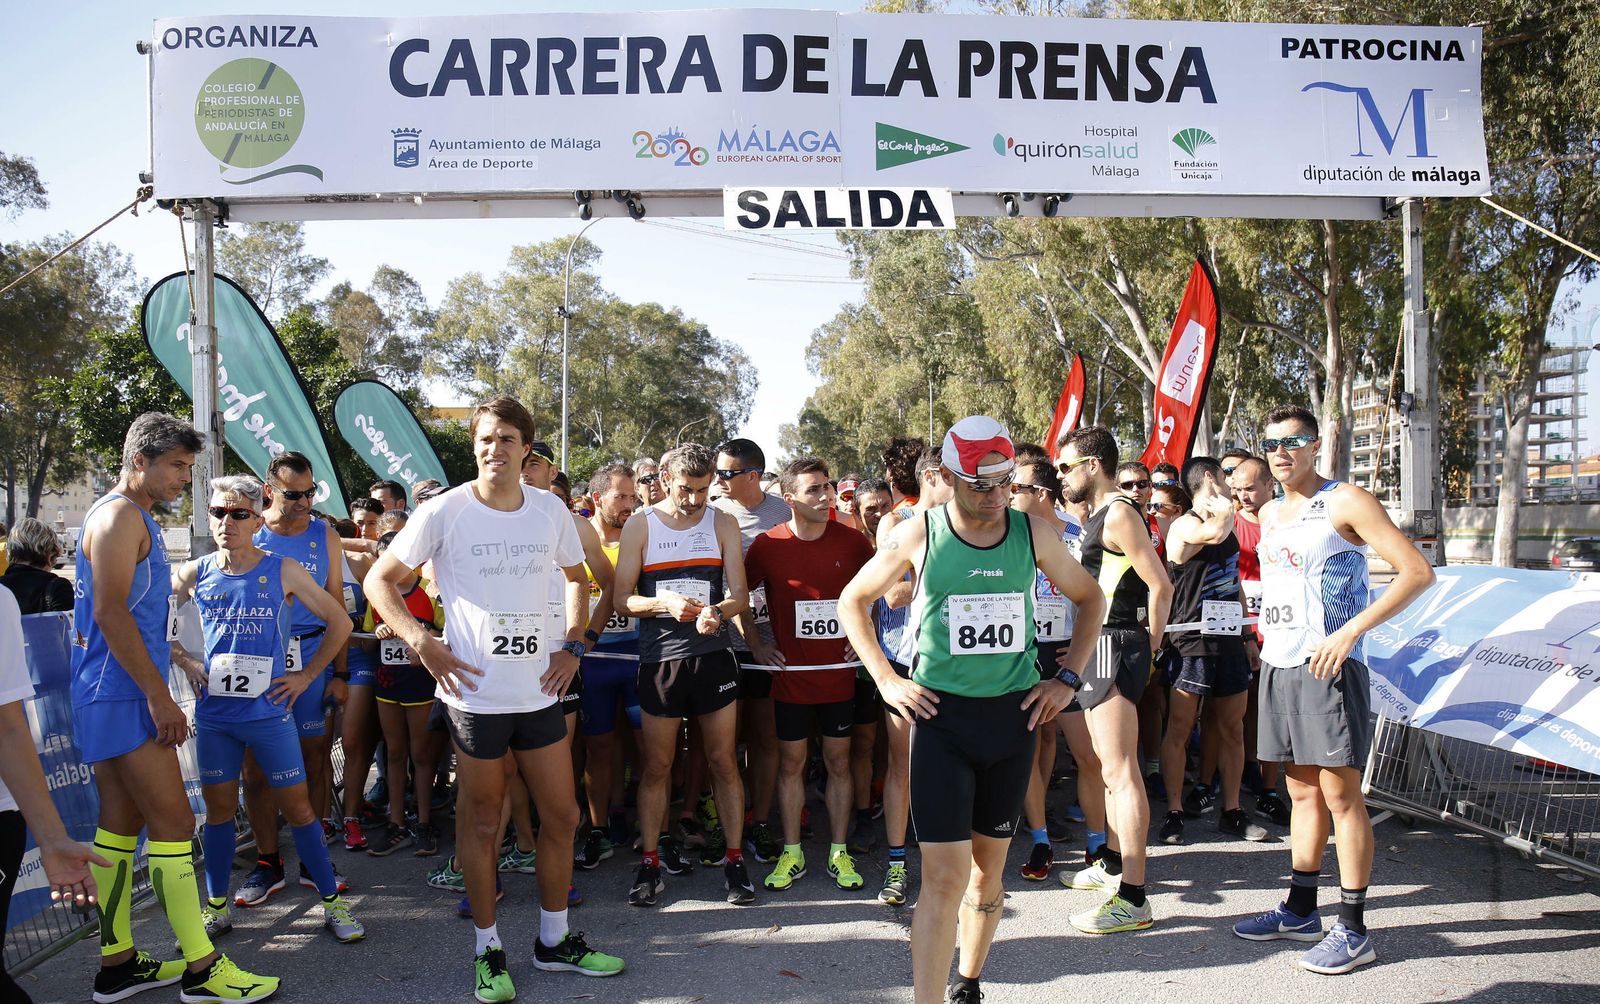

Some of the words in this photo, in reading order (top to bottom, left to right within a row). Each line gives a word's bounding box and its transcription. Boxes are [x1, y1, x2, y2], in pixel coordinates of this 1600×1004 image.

[162, 25, 318, 49] ORGANIZA
[1281, 37, 1465, 61] PATROCINA
[389, 34, 722, 97] CARRERA
[742, 33, 829, 94] DE
[851, 38, 938, 97] LA
[958, 39, 1218, 104] PRENSA
[204, 83, 256, 93] COLEGIO
[204, 95, 282, 106] PROFESIONAL
[285, 95, 300, 105] DE
[204, 108, 275, 119] PERIODISTAS
[279, 108, 293, 117] DE
[204, 119, 268, 131] ANDALUCÍA
[271, 121, 285, 130] EN
[1084, 125, 1138, 139] Hospital
[244, 131, 290, 142] MÁLAGA
[428, 138, 525, 152] Ayuntamiento
[530, 137, 547, 149] de
[551, 137, 601, 151] Málaga
[717, 124, 841, 153] MÁLAGA
[632, 130, 710, 166] 2020
[877, 139, 889, 150] El
[888, 140, 913, 151] Corte
[913, 138, 949, 155] Inglés
[1014, 141, 1139, 162] quirónsalud
[428, 156, 458, 168] Área
[462, 158, 478, 169] de
[482, 158, 534, 170] Deporte
[717, 155, 764, 163] EUROPEAN
[766, 155, 800, 163] CAPITAL
[802, 155, 814, 163] OF
[816, 155, 841, 163] SPORT
[1174, 160, 1218, 168] Fundación
[1092, 165, 1140, 178] Málaga
[1181, 171, 1212, 180] Unicaja
[1303, 165, 1383, 184] diputación
[1388, 168, 1406, 181] de
[1411, 166, 1481, 185] málaga
[736, 188, 946, 228] SALIDA
[479, 559, 505, 578] made
[1265, 604, 1294, 625] 803
[800, 618, 839, 635] 560
[958, 623, 1014, 649] 840
[492, 635, 538, 655] 256
[1475, 645, 1564, 674] diputación
[1565, 664, 1594, 680] de
[221, 674, 250, 693] 12
[1375, 682, 1408, 713] deporte
